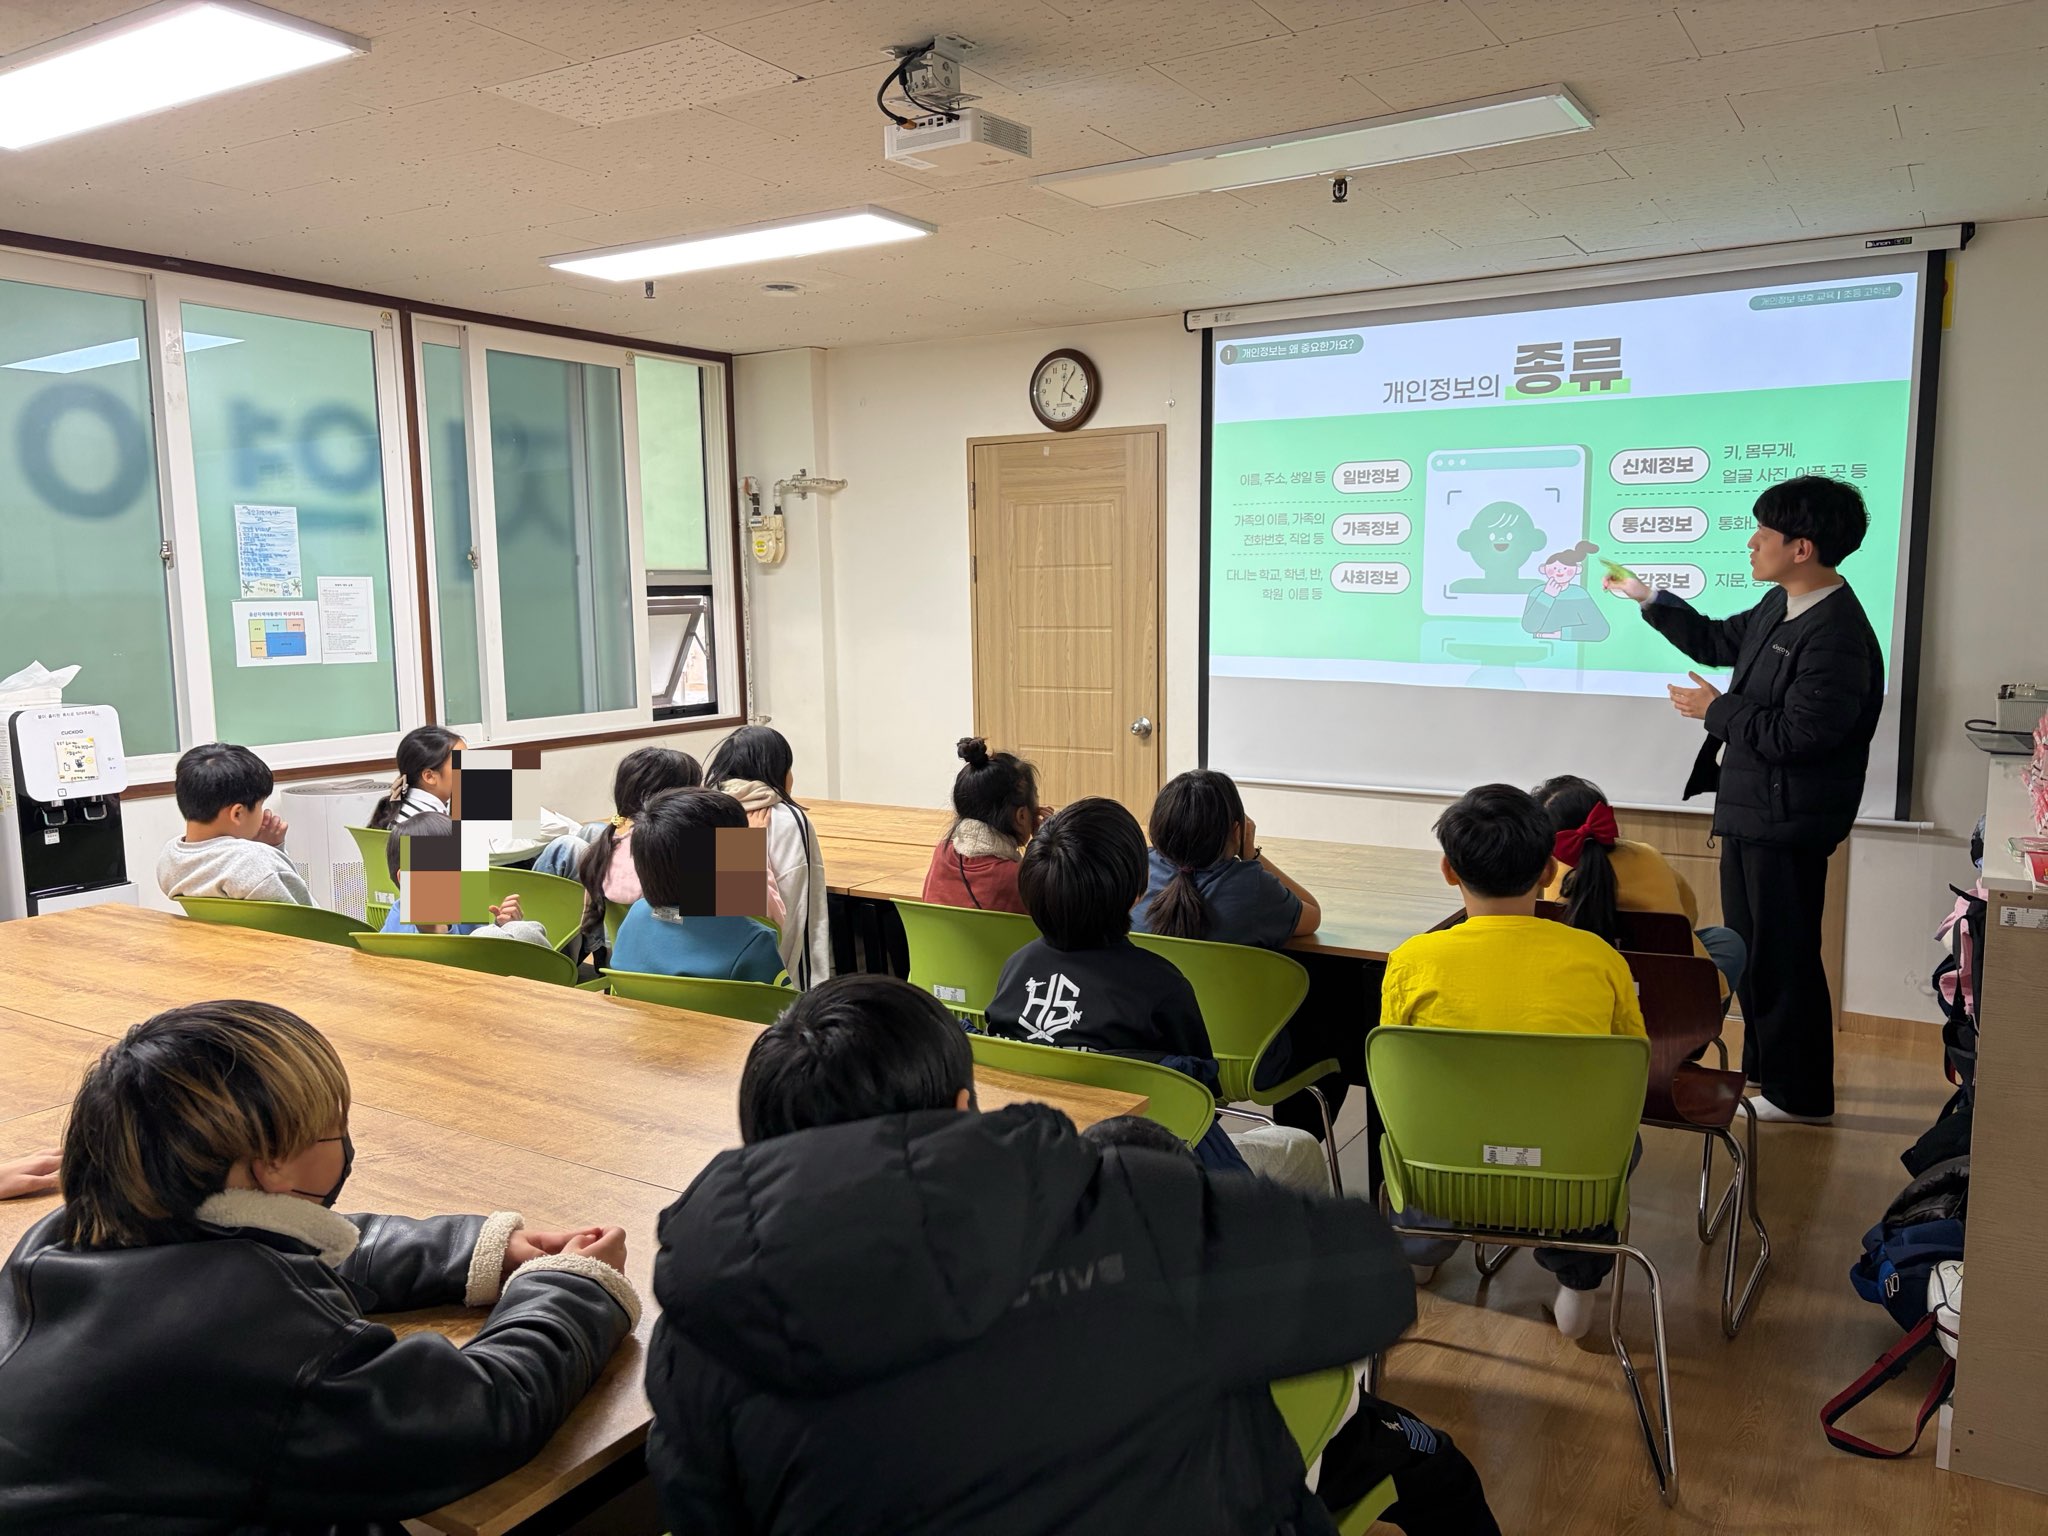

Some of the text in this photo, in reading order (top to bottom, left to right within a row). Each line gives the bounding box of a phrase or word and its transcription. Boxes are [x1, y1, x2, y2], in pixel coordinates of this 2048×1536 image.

[1760, 295, 1795, 306] 개인정보
[1797, 293, 1814, 303] 보호
[1817, 291, 1834, 301] 교육
[1843, 288, 1862, 298] 초등
[1226, 338, 1354, 359] 1 개인정보는 왜 중요한가요?
[1382, 337, 1624, 404] 개인정보의 종류
[1723, 442, 1796, 461] 키, 몸무게,
[1622, 456, 1694, 475] 신체정보
[1722, 468, 1753, 484] 얼굴
[1850, 463, 1868, 479] 등
[1240, 471, 1326, 486] 이름, 주소, 생일 등
[1343, 468, 1400, 485] 일반정보
[1234, 513, 1325, 527] 가족의 이름, 가족의
[1622, 516, 1693, 533] 통신정보
[1342, 521, 1400, 536] 가족정보
[1243, 533, 1325, 547] 전화번호, 직업 등
[1226, 568, 1323, 581] 다니는 학교, 학년, 반,
[1341, 570, 1399, 585] 사회정보
[1714, 573, 1748, 588] 지문,
[1262, 588, 1323, 601] 학원 이름 등
